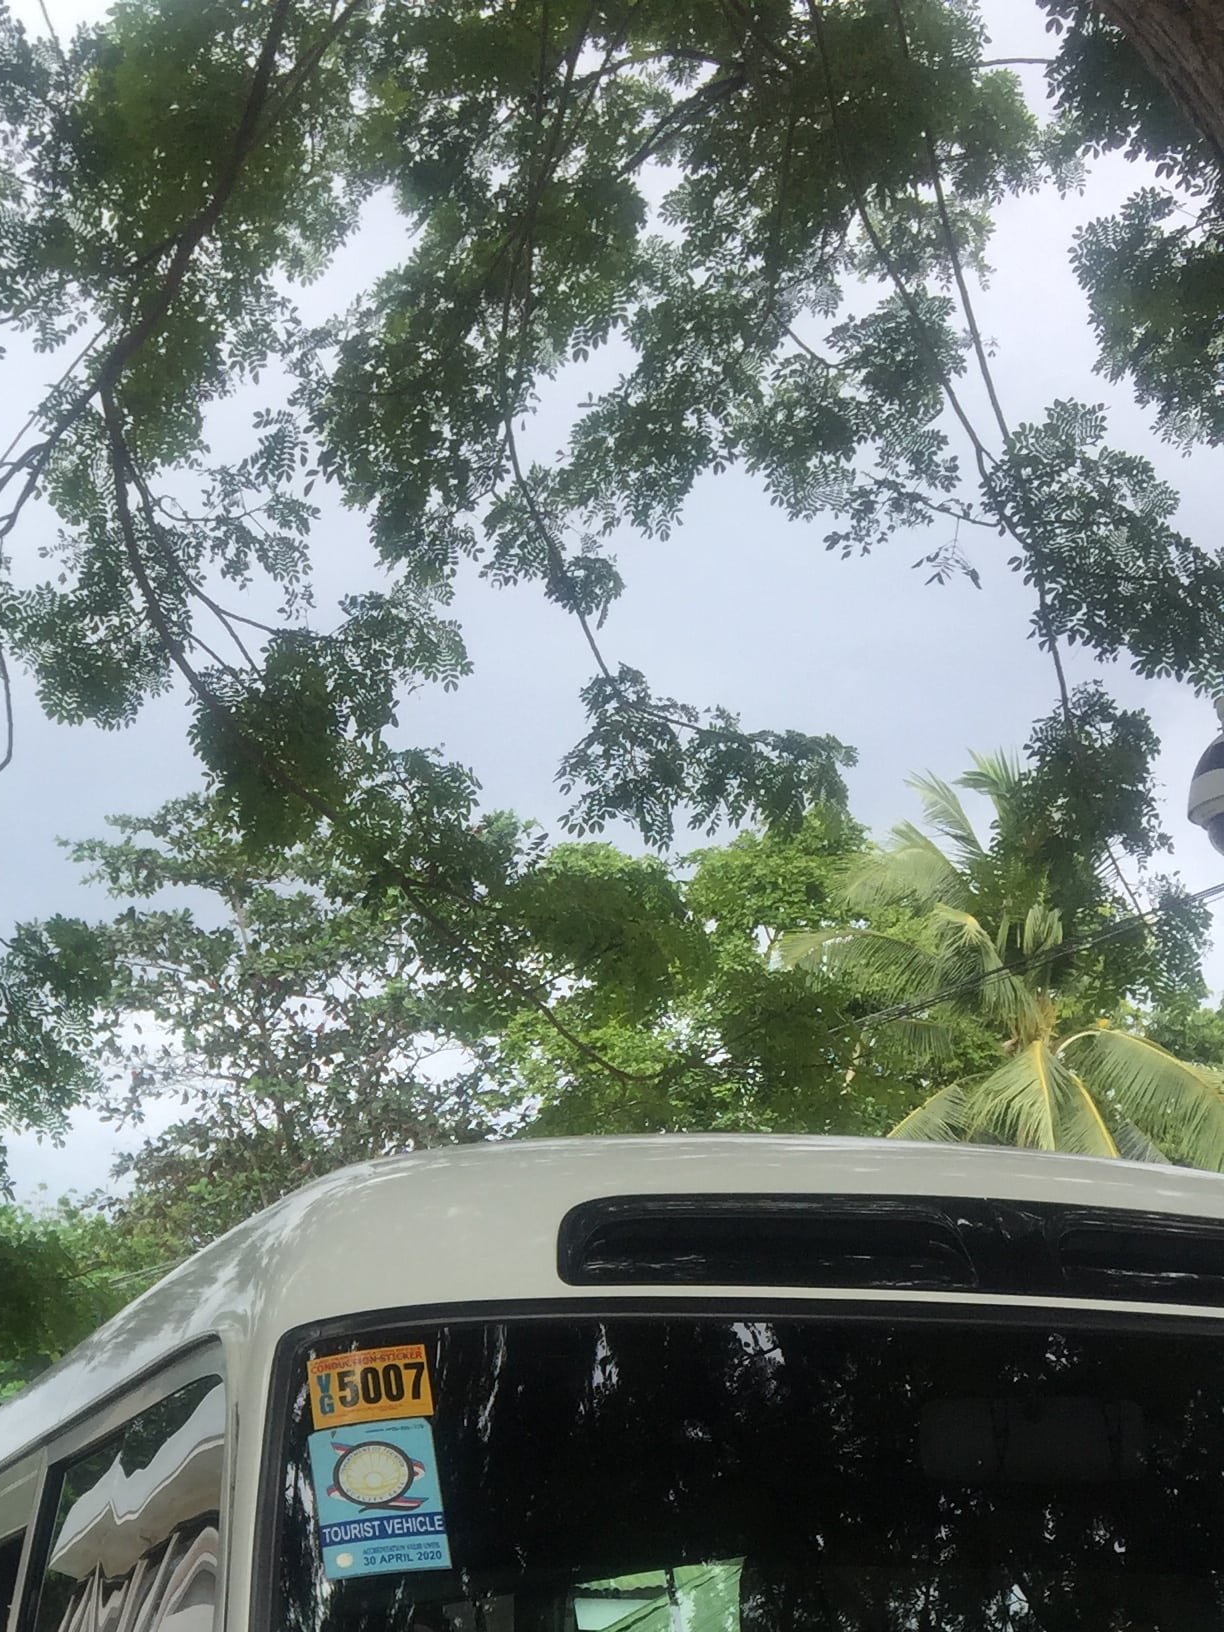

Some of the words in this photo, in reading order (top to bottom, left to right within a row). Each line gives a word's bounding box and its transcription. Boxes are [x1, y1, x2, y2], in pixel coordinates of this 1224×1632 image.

[337, 1362, 425, 1408] 5007
[322, 1521, 381, 1543] TOURIST
[384, 1515, 445, 1535] VEHICLE
[364, 1556, 376, 1566] 30
[380, 1553, 414, 1564] APRIL
[416, 1550, 442, 1561] 2020
